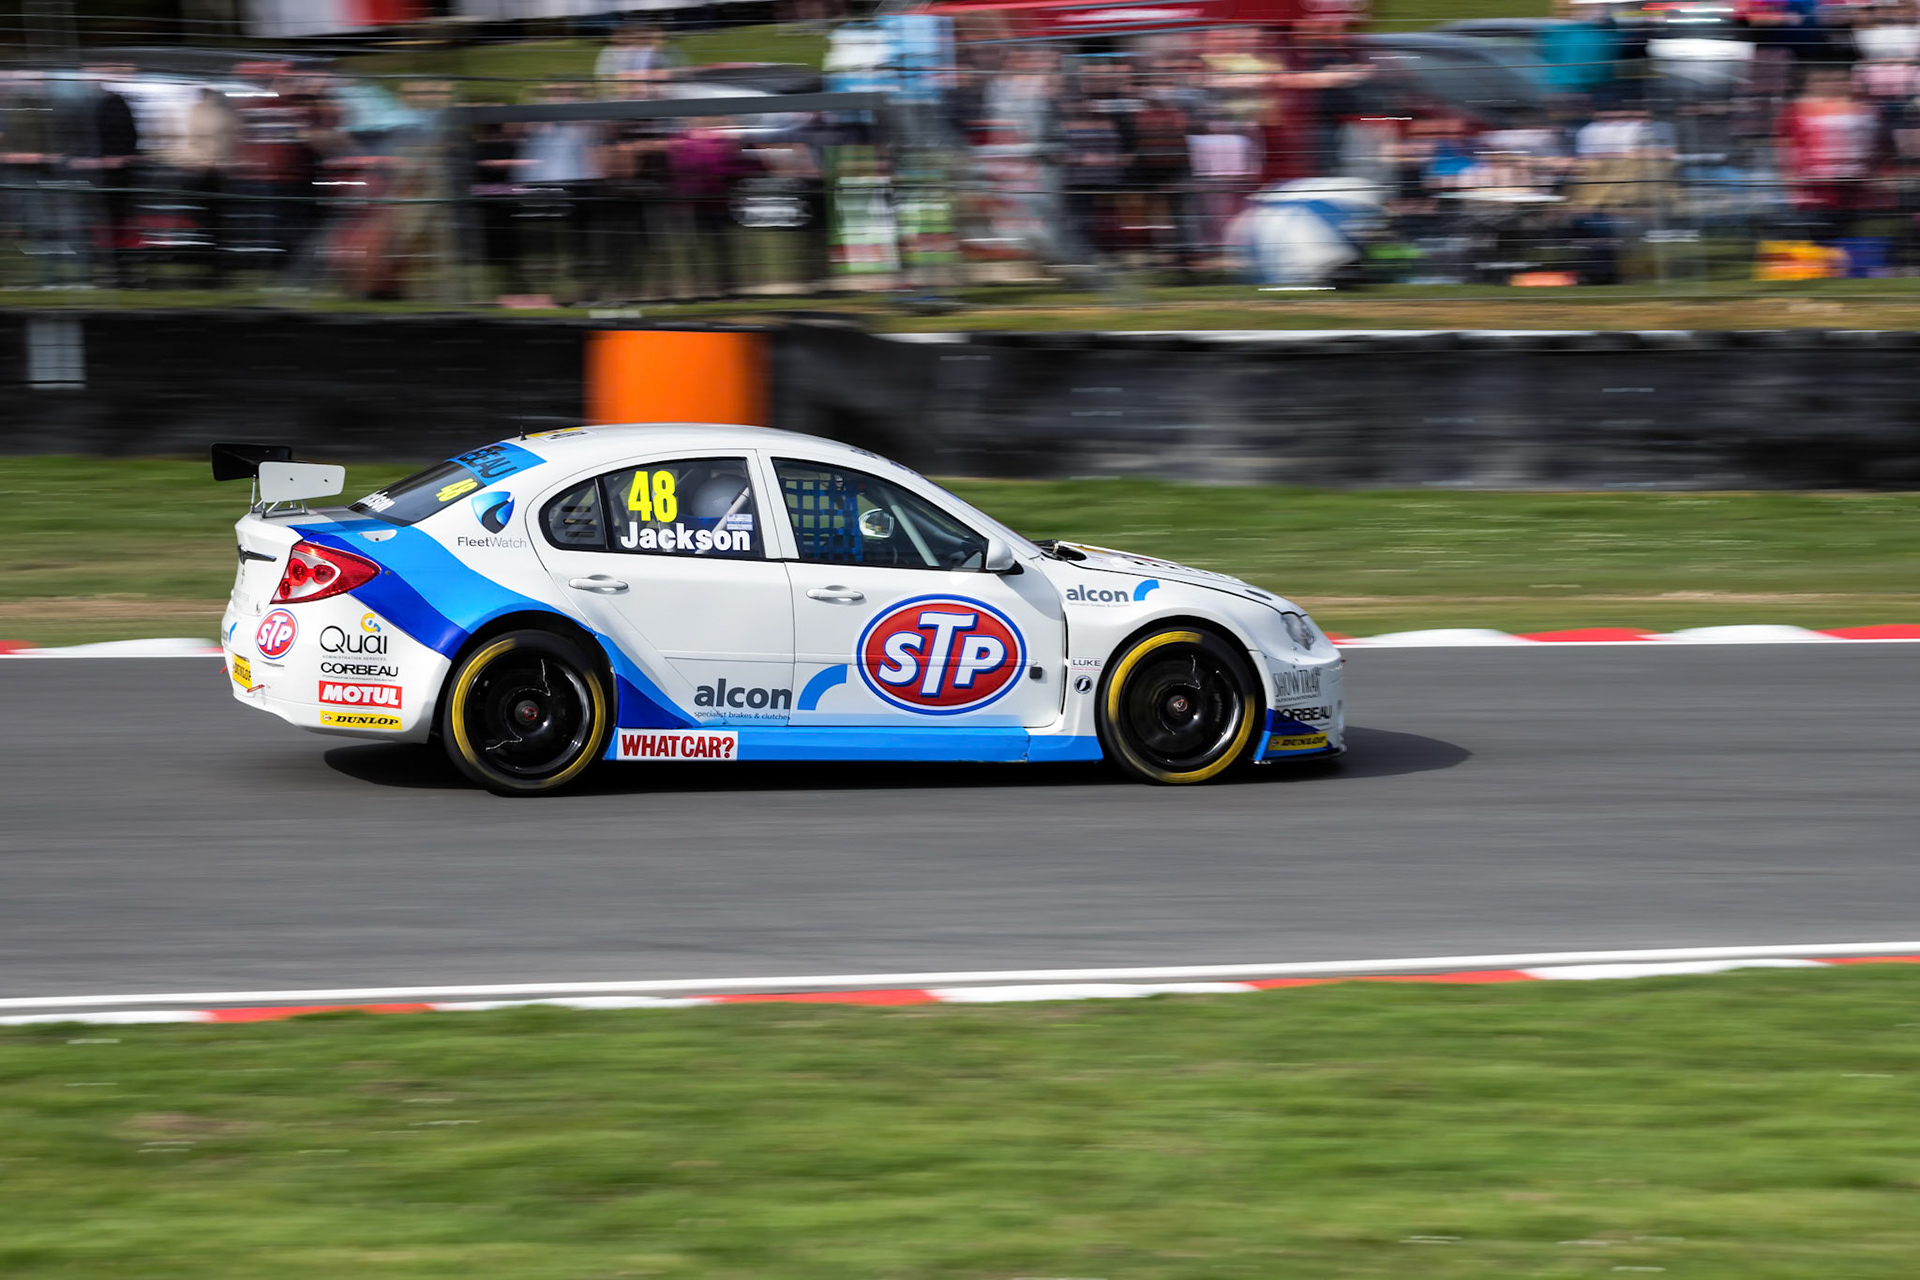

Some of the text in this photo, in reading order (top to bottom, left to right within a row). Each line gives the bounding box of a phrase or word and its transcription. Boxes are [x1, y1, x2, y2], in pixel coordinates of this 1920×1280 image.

[628, 470, 678, 523] 48
[457, 536, 527, 549] FleetWatch
[620, 521, 751, 551] Jackson
[1066, 584, 1129, 602] alcon
[257, 615, 293, 651] STP
[877, 611, 1007, 697] STP
[1072, 659, 1102, 667] LUKE
[320, 661, 399, 677] CORBEAU
[321, 685, 400, 706] MOTUL
[693, 678, 793, 710] alcon
[335, 715, 399, 726] DUNLOP
[728, 711, 752, 719] brakes
